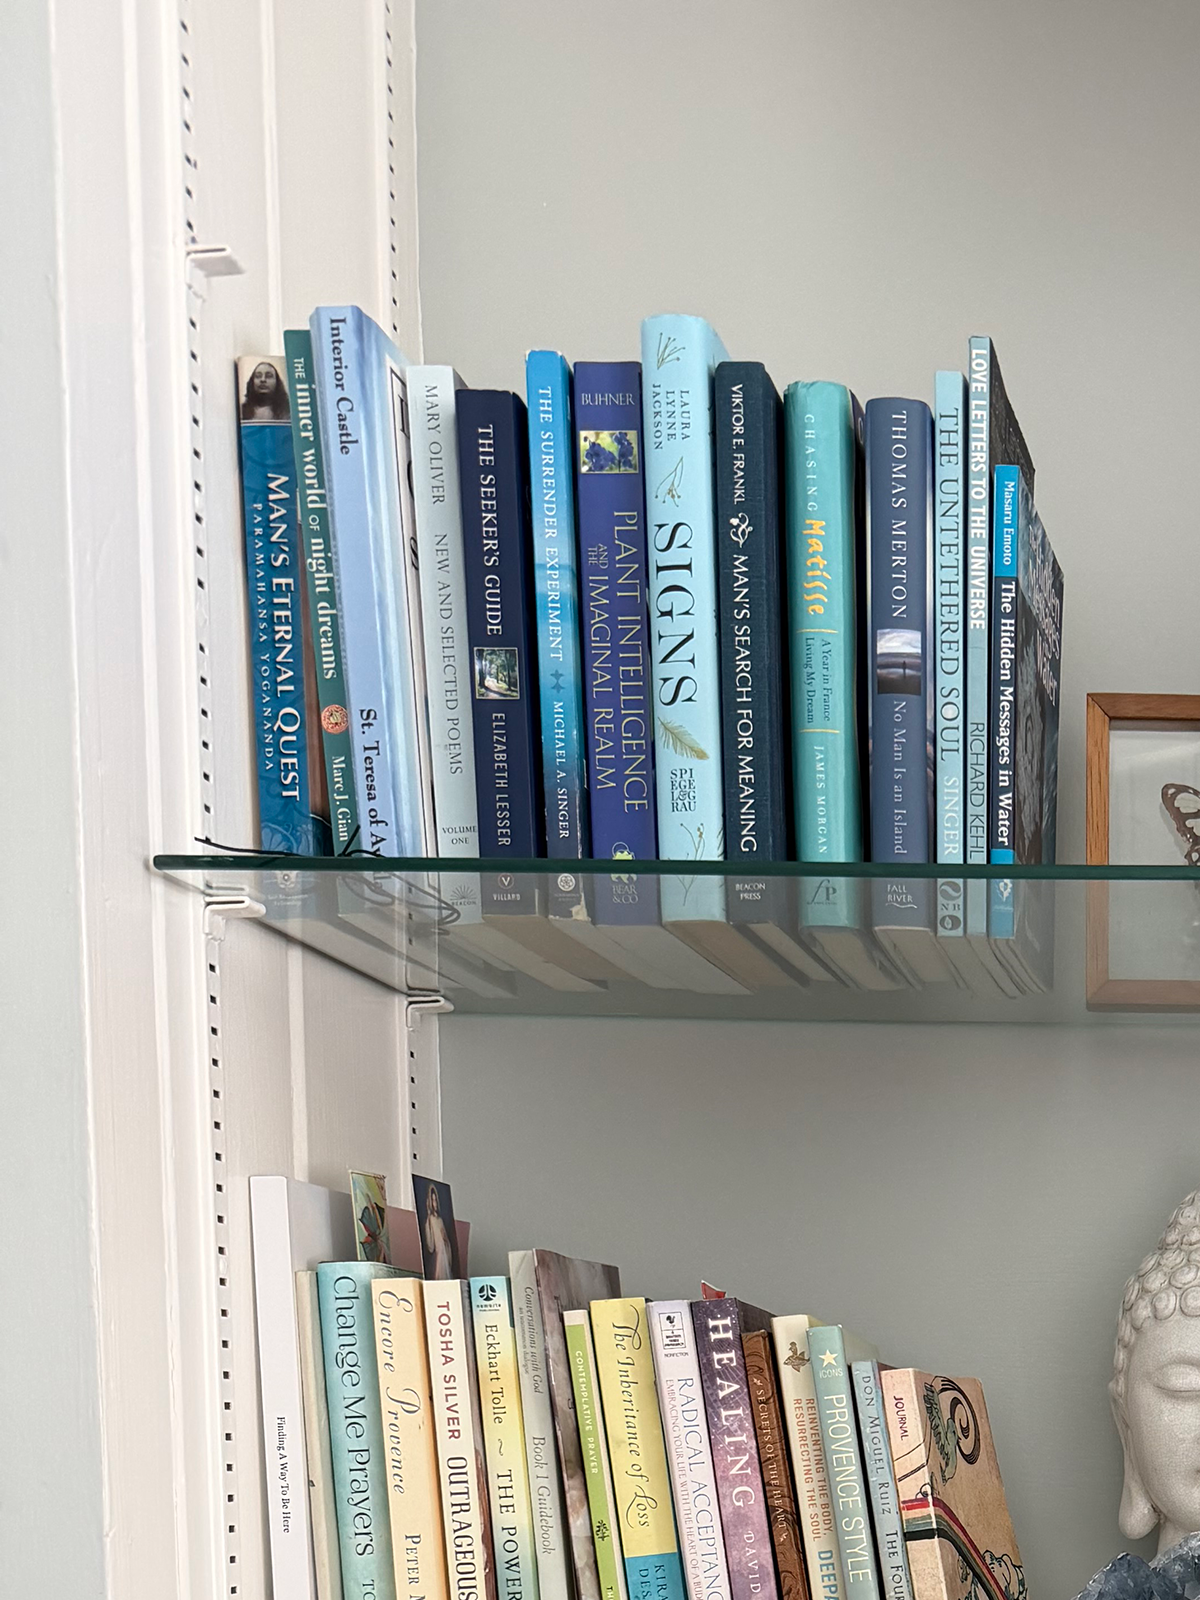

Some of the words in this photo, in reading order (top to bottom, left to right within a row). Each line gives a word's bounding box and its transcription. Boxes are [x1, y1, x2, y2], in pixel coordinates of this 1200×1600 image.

[295, 358, 304, 380] THE
[330, 317, 348, 392] Interior
[971, 349, 987, 393] LOVE
[297, 384, 315, 440] inner
[336, 396, 358, 455] Castle
[425, 385, 439, 434] MARY
[538, 386, 551, 422] THE
[581, 393, 634, 405] BUHNER
[478, 424, 495, 467] THE
[804, 413, 817, 511] CHASING
[892, 411, 907, 508] THOMAS
[939, 408, 959, 468] THE
[971, 401, 986, 473] LETTERS
[302, 447, 327, 509] world
[429, 443, 445, 505] OLIVER
[541, 432, 557, 540] SURRENDER
[971, 480, 986, 499] TO
[267, 473, 290, 567] MAN'S
[309, 514, 320, 531] OF
[479, 475, 500, 569] SEEKER'S
[971, 505, 986, 538] THE
[305, 538, 333, 592] night
[614, 510, 640, 603] PLANT
[733, 554, 750, 618] MAN'S
[803, 520, 831, 615] Matisse
[892, 518, 907, 618] MERTON
[939, 478, 960, 676] UNTETHERED
[970, 545, 986, 629] UNIVERSE
[485, 575, 502, 636] GUIDE
[545, 547, 563, 661] EXPERIMENT
[655, 521, 697, 707] SIGNS
[1001, 581, 1016, 613] The
[271, 577, 295, 696] ETERNAL
[317, 601, 336, 680] dreams
[589, 576, 612, 698] IMAGINAL
[735, 623, 753, 704] SEARCH
[1000, 618, 1015, 680] Hidden
[618, 614, 647, 813] INTELLIGENCE
[737, 709, 754, 749] FOR
[940, 688, 960, 760] SOUL
[996, 687, 1013, 764] Messages
[274, 707, 301, 801] QUEST
[594, 708, 615, 792] REALM
[999, 768, 1012, 787] in
[442, 825, 477, 834] VOLUME
[739, 755, 756, 853] MEANING
[945, 776, 960, 856] SINGER
[998, 794, 1012, 845] Water
[735, 882, 766, 891] BEACON
[740, 892, 761, 900] PRESS
[887, 884, 906, 893] FALL
[333, 1276, 360, 1387] Change
[378, 1290, 413, 1373] Encore
[342, 1395, 368, 1438] Me
[385, 1387, 421, 1495] Provence
[618, 1356, 640, 1457] Inheritance
[677, 1378, 704, 1471] RADICAL
[708, 1317, 754, 1507] HEALING
[893, 1396, 908, 1441] JOURNAL
[824, 1394, 861, 1510] PROVENCE
[347, 1448, 374, 1557] Prayers
[497, 1470, 516, 1514] THE
[842, 1517, 871, 1582] STYLE
